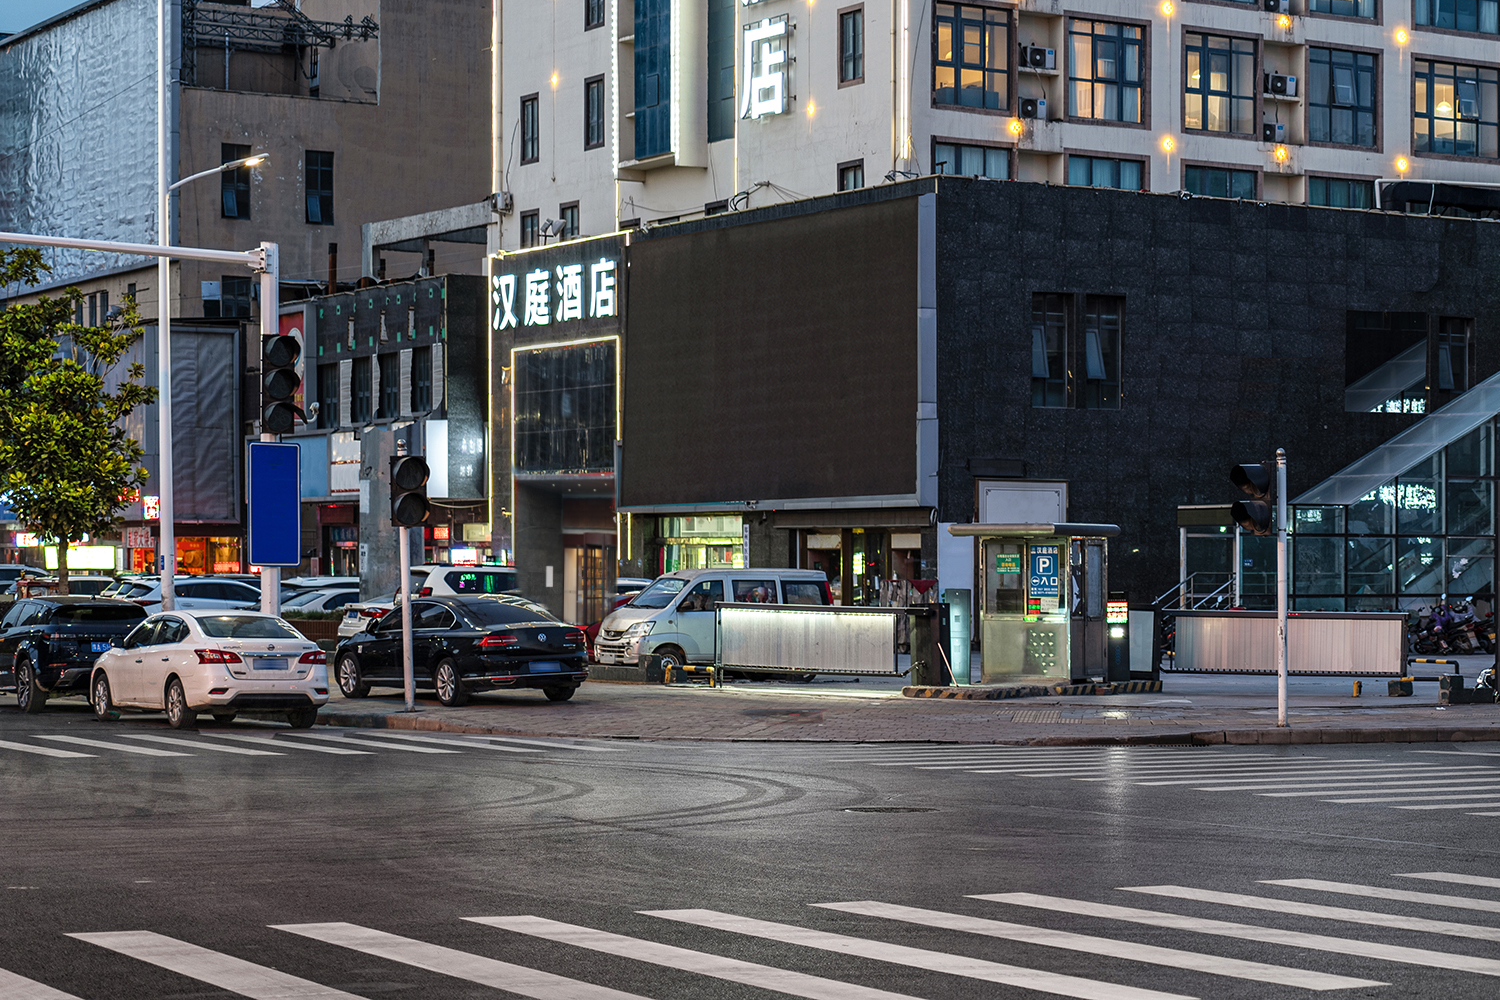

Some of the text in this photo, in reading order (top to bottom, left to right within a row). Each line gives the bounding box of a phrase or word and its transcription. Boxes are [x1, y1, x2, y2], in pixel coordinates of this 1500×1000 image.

[492, 257, 617, 331] 汉庭酒店
[1039, 558, 1050, 572] P
[1040, 577, 1058, 585] 入口
